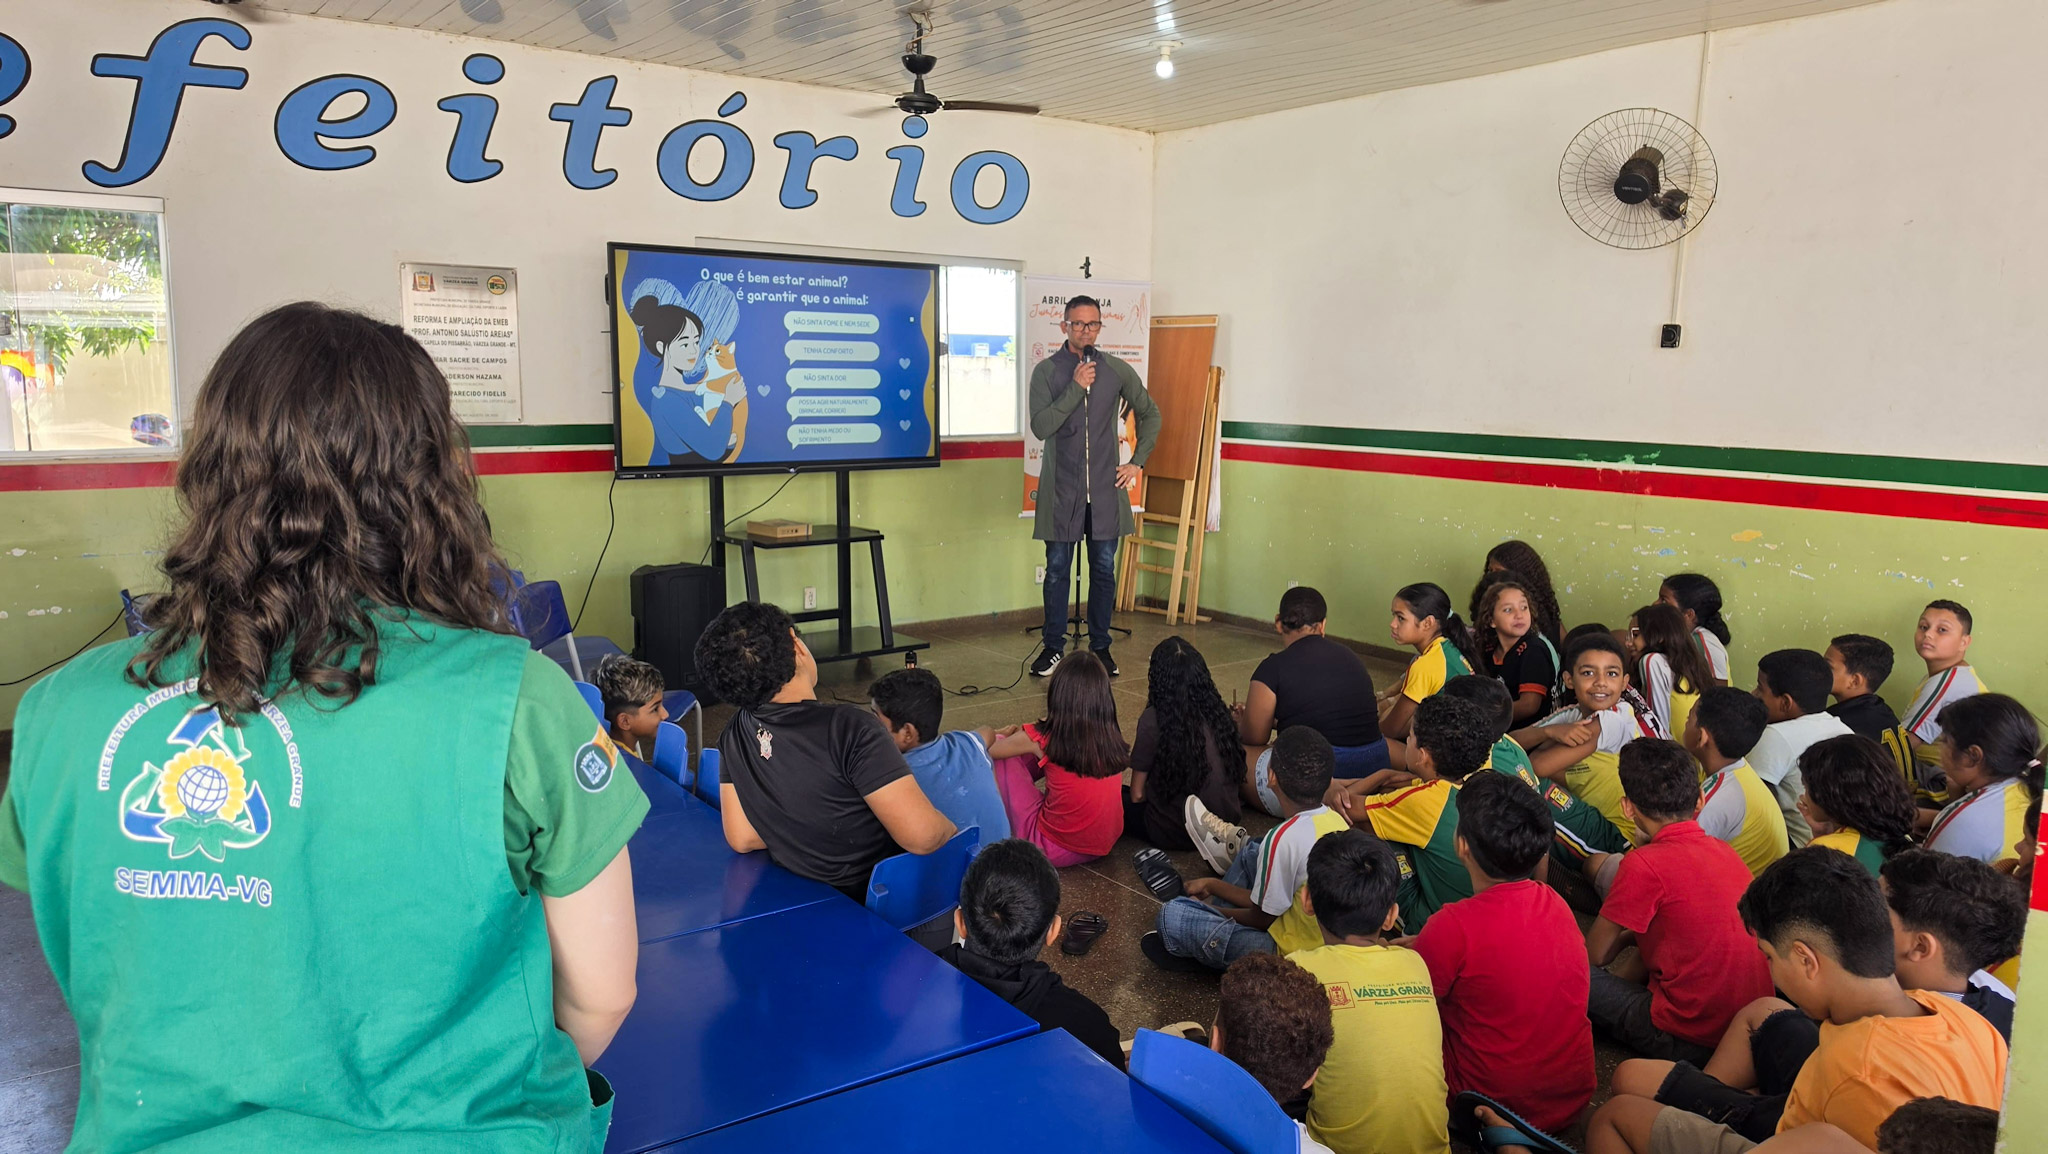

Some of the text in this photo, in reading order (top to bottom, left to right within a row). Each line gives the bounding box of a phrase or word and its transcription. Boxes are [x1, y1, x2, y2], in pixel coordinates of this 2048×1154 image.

[0, 18, 1031, 224] feitório
[700, 268, 848, 288] O que é bem estar animal?
[736, 287, 869, 306] é garantir que o animal:
[1042, 296, 1067, 305] ABRIL
[413, 315, 509, 327] REFORMA E AMPLIAÇÃO DA EMEB
[793, 317, 806, 325] NÃO
[823, 319, 839, 327] FOME
[432, 328, 459, 337] ANTONIO
[823, 347, 854, 355] CONFORTO
[804, 373, 817, 382] NÃO
[798, 426, 810, 434] NÃO
[100, 703, 148, 790] PREFEITURA
[288, 744, 302, 807] GRANDE
[116, 867, 271, 906] SEMMA-VG
[1353, 986, 1398, 998] VÁRZEA
